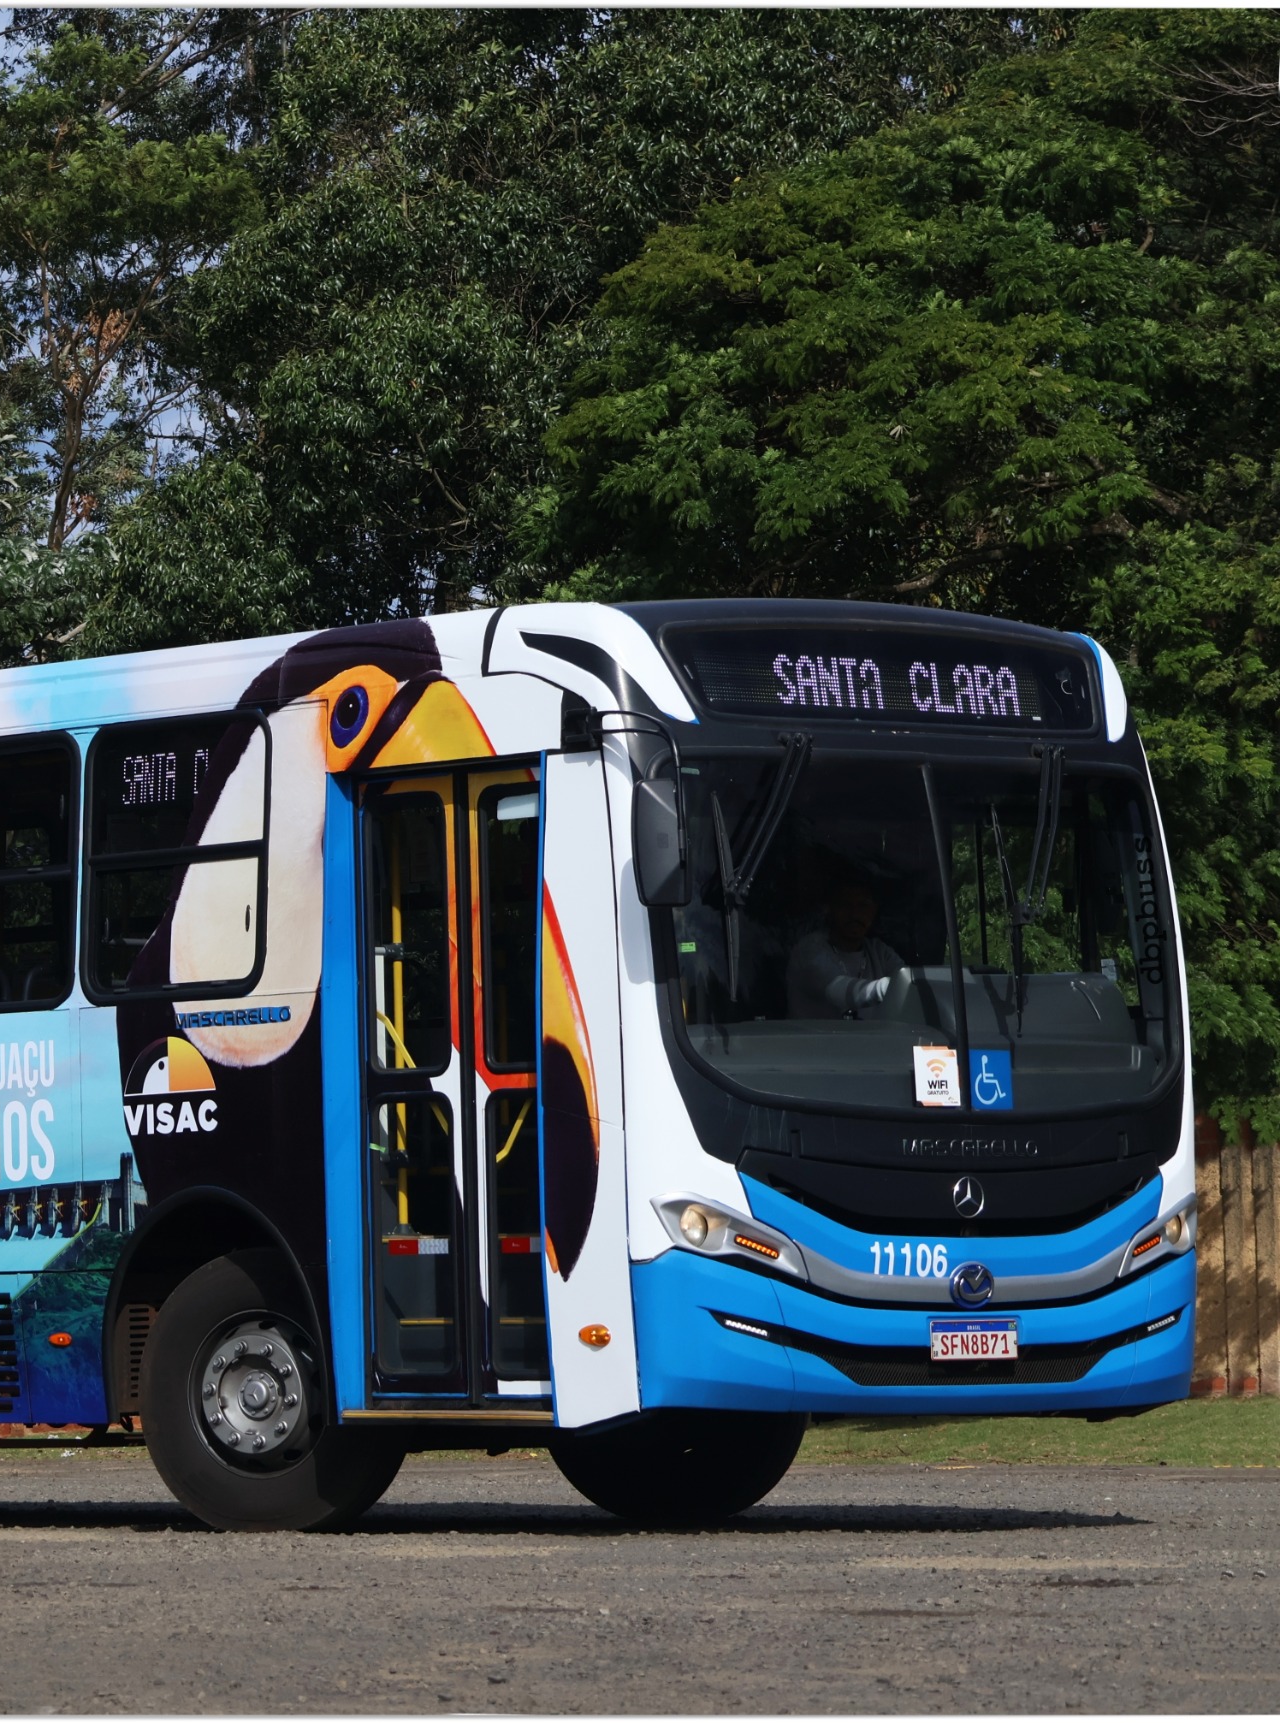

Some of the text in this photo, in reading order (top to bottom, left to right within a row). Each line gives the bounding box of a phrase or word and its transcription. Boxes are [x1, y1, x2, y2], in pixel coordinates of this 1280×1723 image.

[773, 654, 1021, 717] SANTA CLARA
[122, 752, 177, 804] SANTA
[175, 1005, 292, 1029] MASCARELLO
[927, 1079, 949, 1090] WIFI
[123, 1099, 219, 1136] VISAC
[869, 1241, 949, 1279] 11106
[940, 1333, 1010, 1356] SFN8B71
